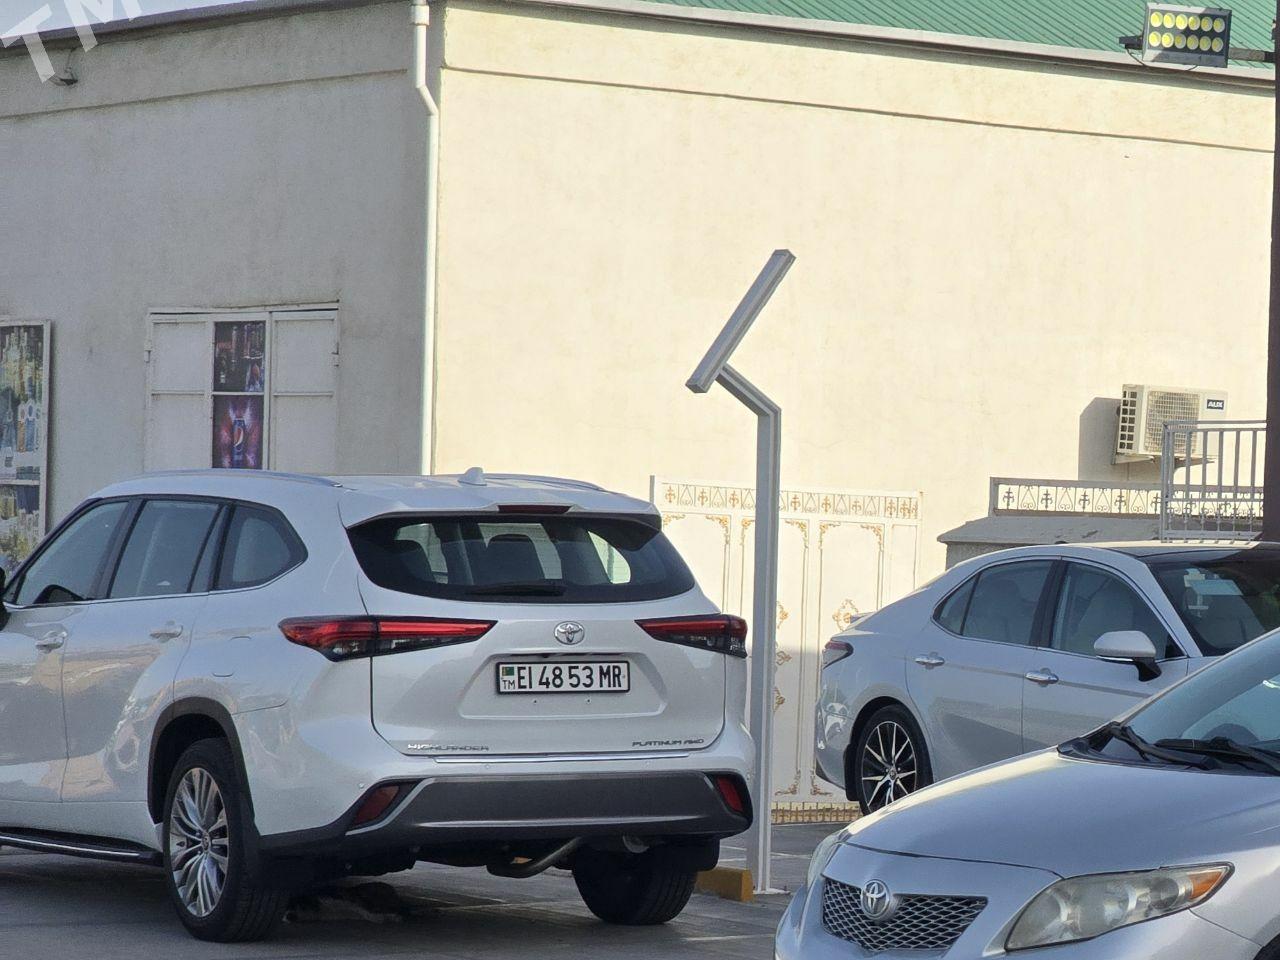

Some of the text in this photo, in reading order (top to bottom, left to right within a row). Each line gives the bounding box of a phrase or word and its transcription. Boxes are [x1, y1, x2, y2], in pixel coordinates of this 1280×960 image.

[1207, 400, 1223, 409] AUX
[502, 679, 516, 690] TM
[598, 665, 622, 688] MR
